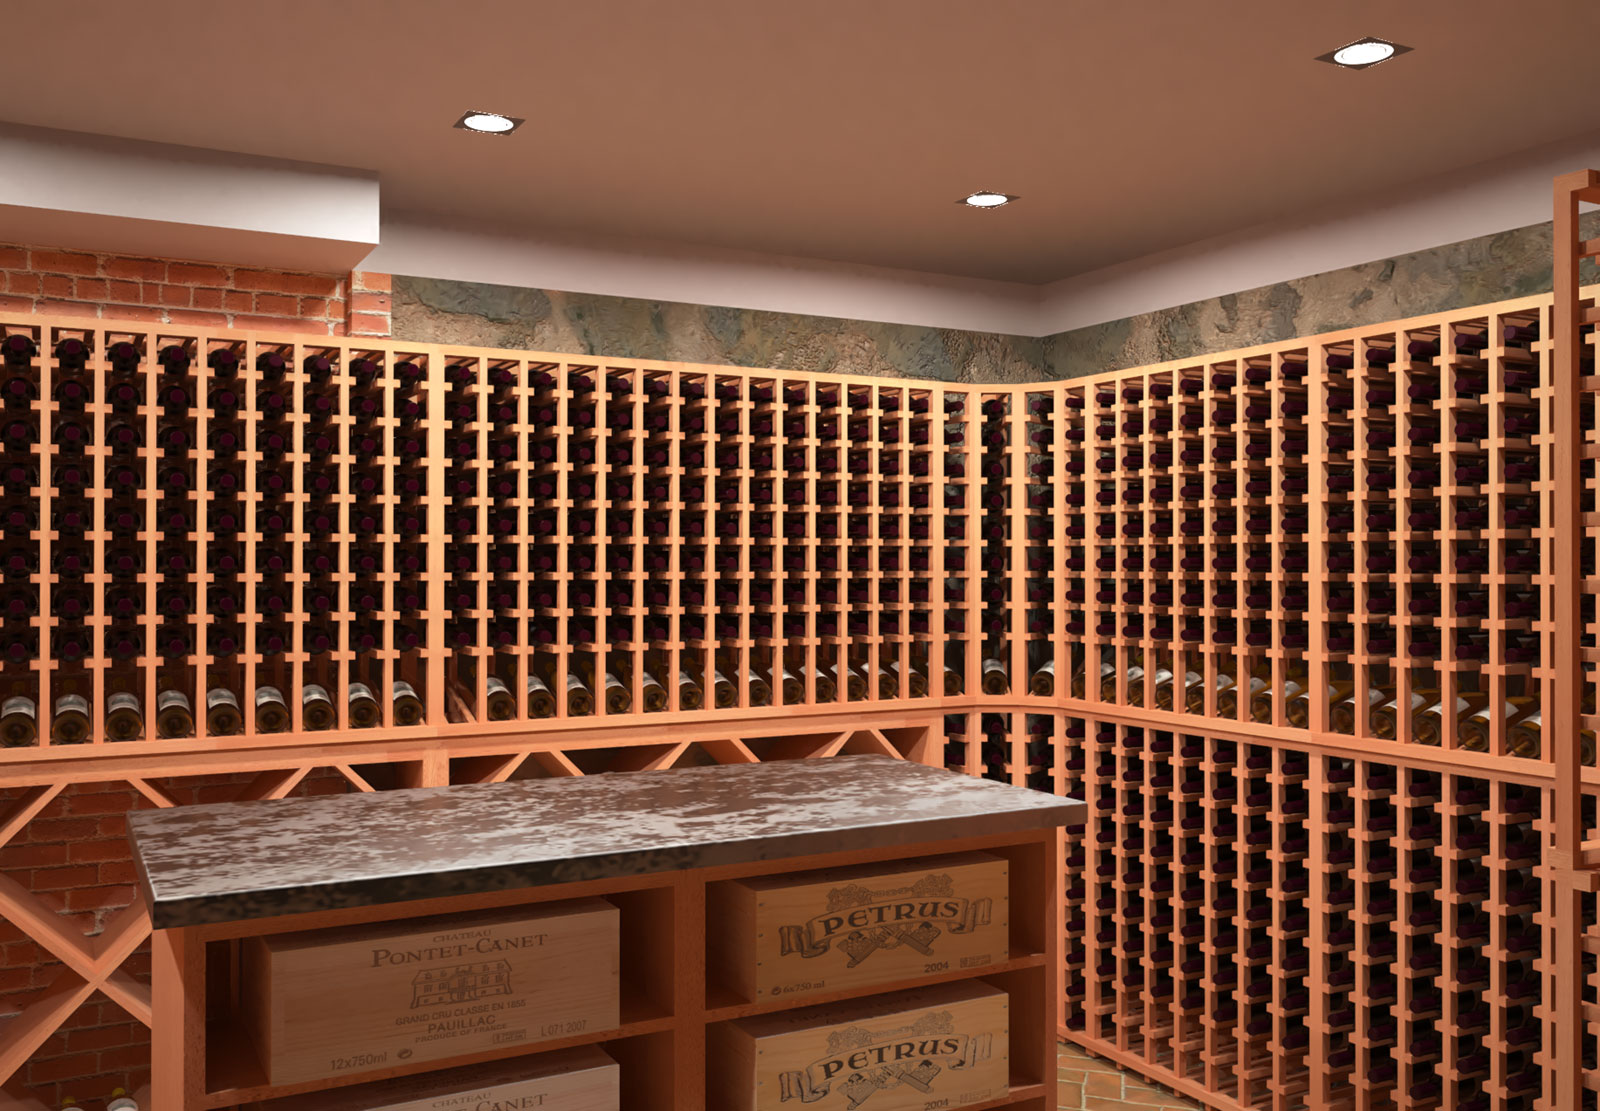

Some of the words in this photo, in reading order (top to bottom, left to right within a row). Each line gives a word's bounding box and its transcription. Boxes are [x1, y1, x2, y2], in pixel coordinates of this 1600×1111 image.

[818, 902, 959, 937] PETRUS
[370, 934, 548, 968] PONTET-CANET
[924, 961, 949, 973] 2004
[783, 982, 812, 994] 6x750
[813, 979, 825, 989] ml
[395, 1013, 430, 1026] GRAND
[432, 1009, 452, 1021] CRU
[492, 1002, 505, 1012] EN
[507, 999, 527, 1010] 1855
[415, 1030, 458, 1044] PRODUCE
[460, 1028, 472, 1037] OF
[473, 1023, 508, 1034] FRANCE
[428, 1014, 496, 1034] PAUILLAC
[548, 1023, 565, 1036] 071
[566, 1020, 587, 1032] 2007
[330, 1051, 388, 1071] 12x750ml
[818, 1038, 959, 1081] PETRUS
[924, 1098, 949, 1111] 2004
